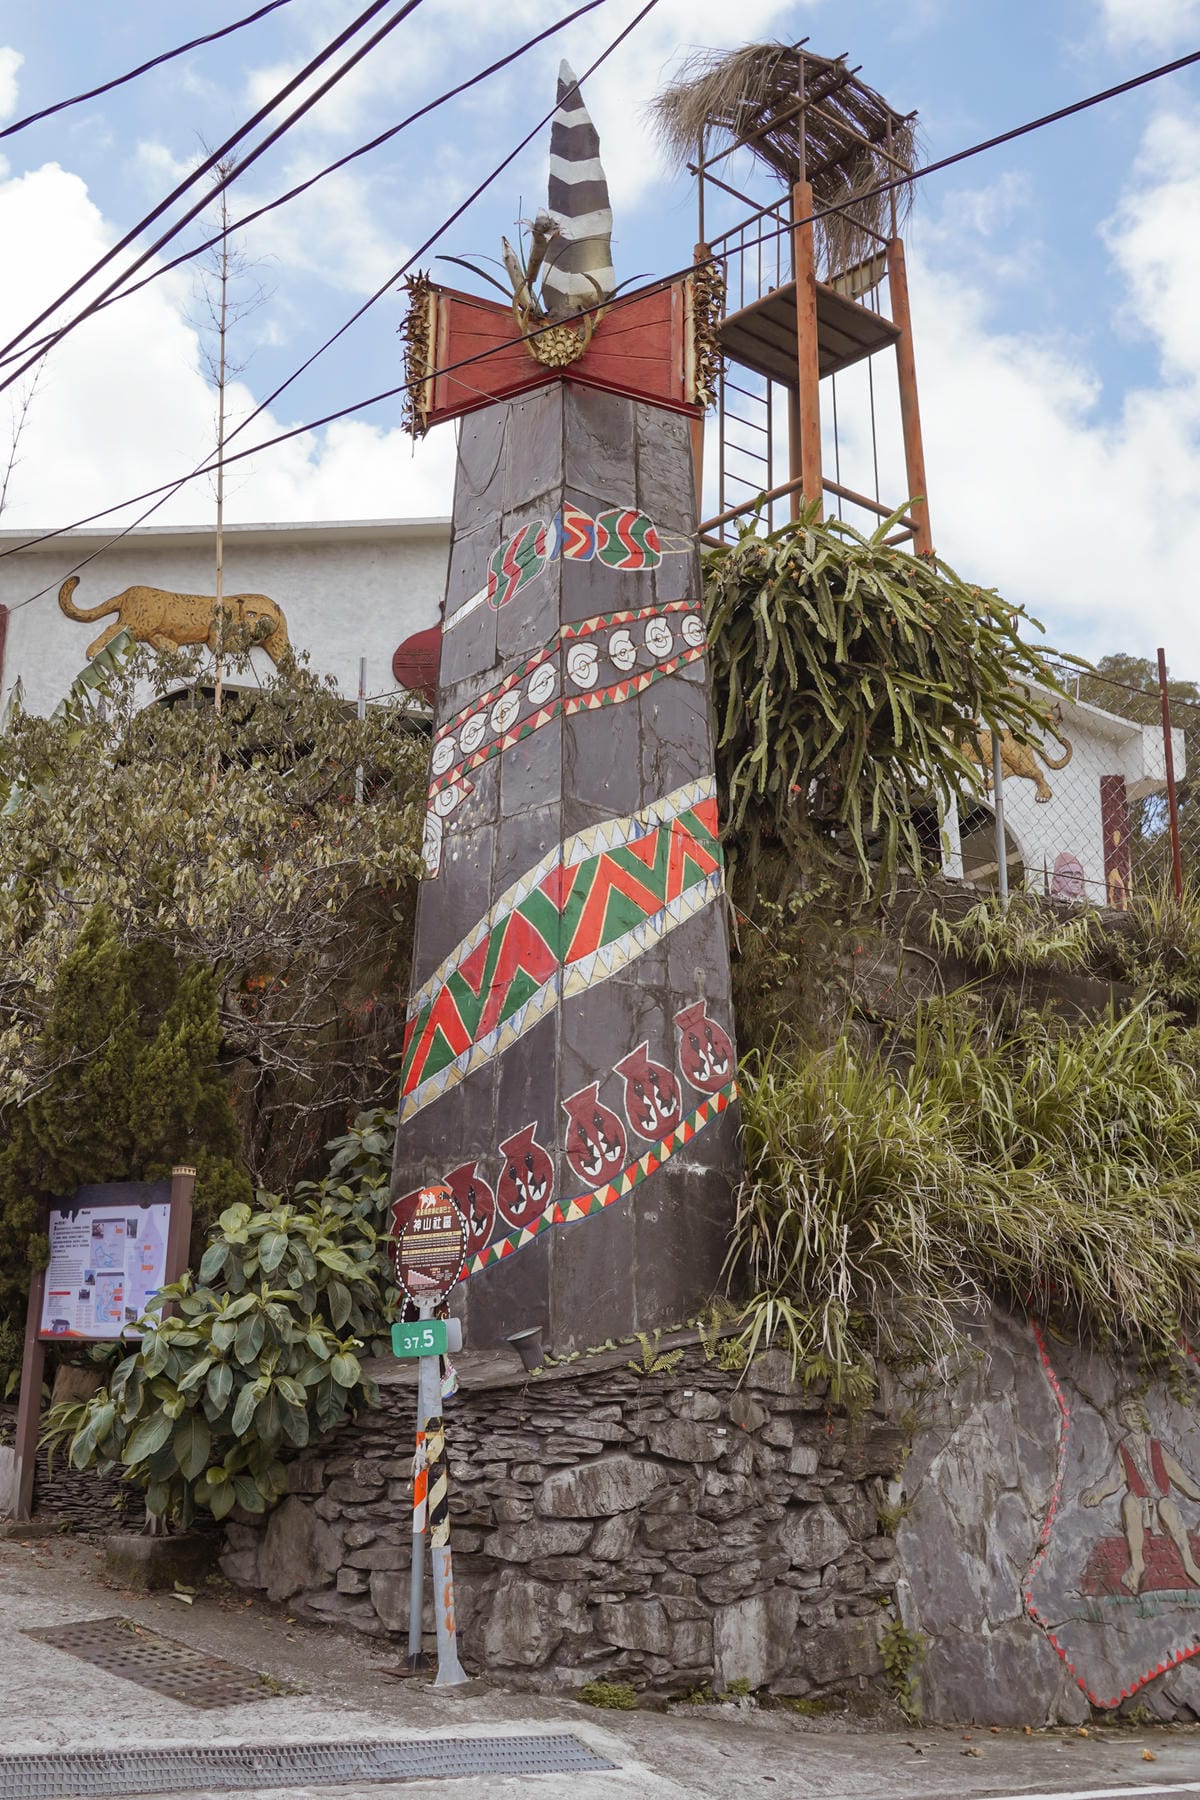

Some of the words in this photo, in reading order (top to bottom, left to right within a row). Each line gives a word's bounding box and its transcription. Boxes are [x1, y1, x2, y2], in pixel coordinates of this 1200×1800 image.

[413, 1215, 452, 1232] 神山社區
[403, 1329, 434, 1349] 37.5
